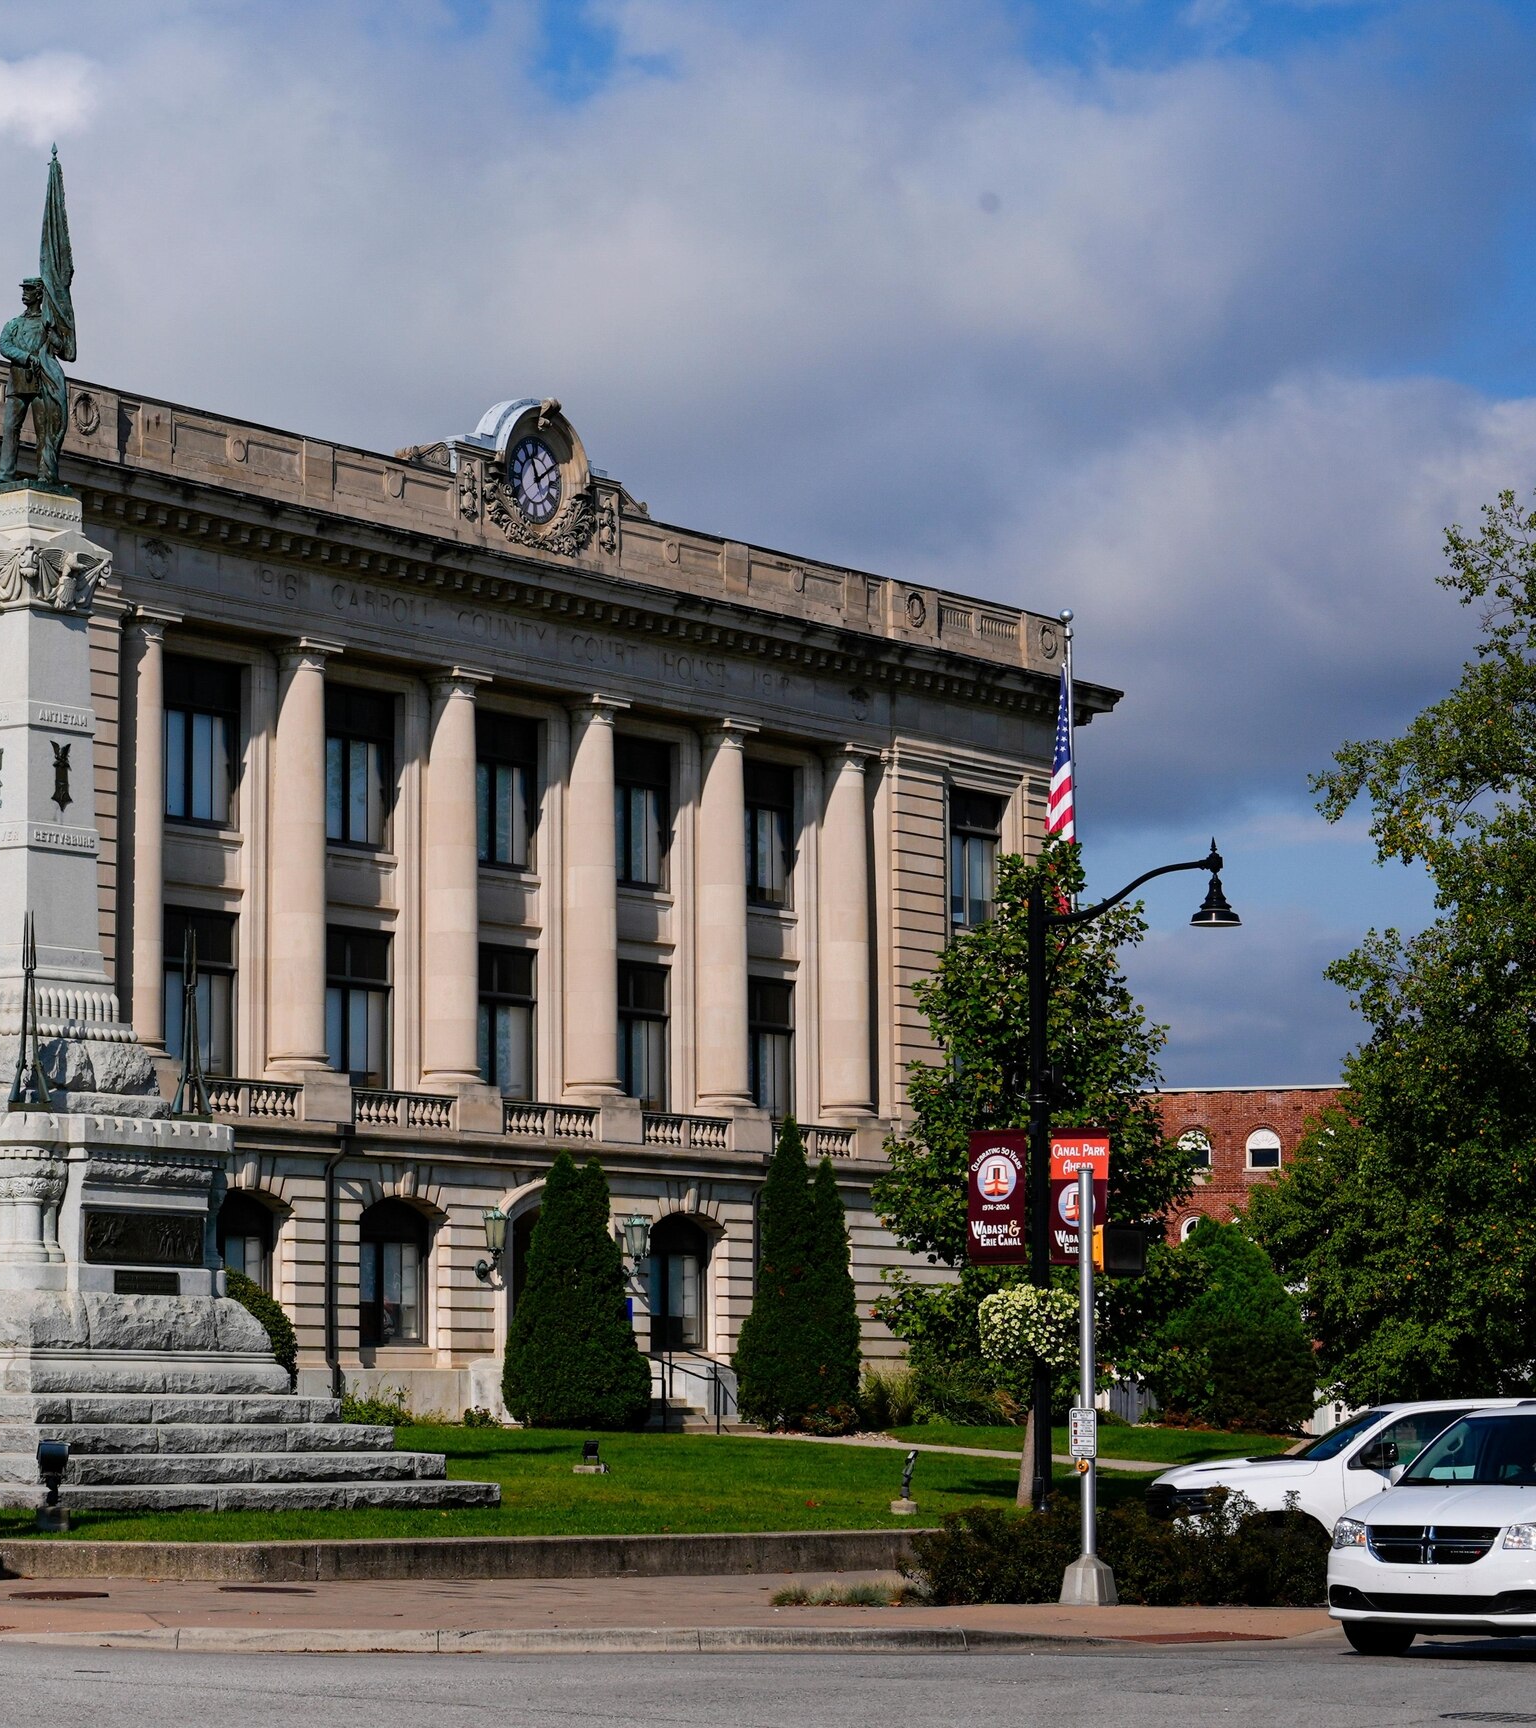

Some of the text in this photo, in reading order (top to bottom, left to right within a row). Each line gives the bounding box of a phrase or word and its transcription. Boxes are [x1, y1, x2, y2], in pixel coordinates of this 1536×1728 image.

[331, 584, 434, 629] CARROLL
[457, 610, 547, 648] COUNTY
[571, 634, 638, 667] COURT
[663, 653, 726, 688] HOUSE
[38, 709, 88, 728] ANTIETAM
[33, 829, 95, 849] GETTYSBURG
[970, 1146, 1022, 1171] CELEBRATING 50 YEARS
[1052, 1143, 1105, 1159] CANAL PARK
[1062, 1159, 1093, 1175] AHEAD
[970, 1219, 1021, 1239] WABASH &
[980, 1233, 1022, 1247] ERIE CANAL
[1054, 1230, 1079, 1247] WABA
[1064, 1243, 1079, 1254] ERIE
